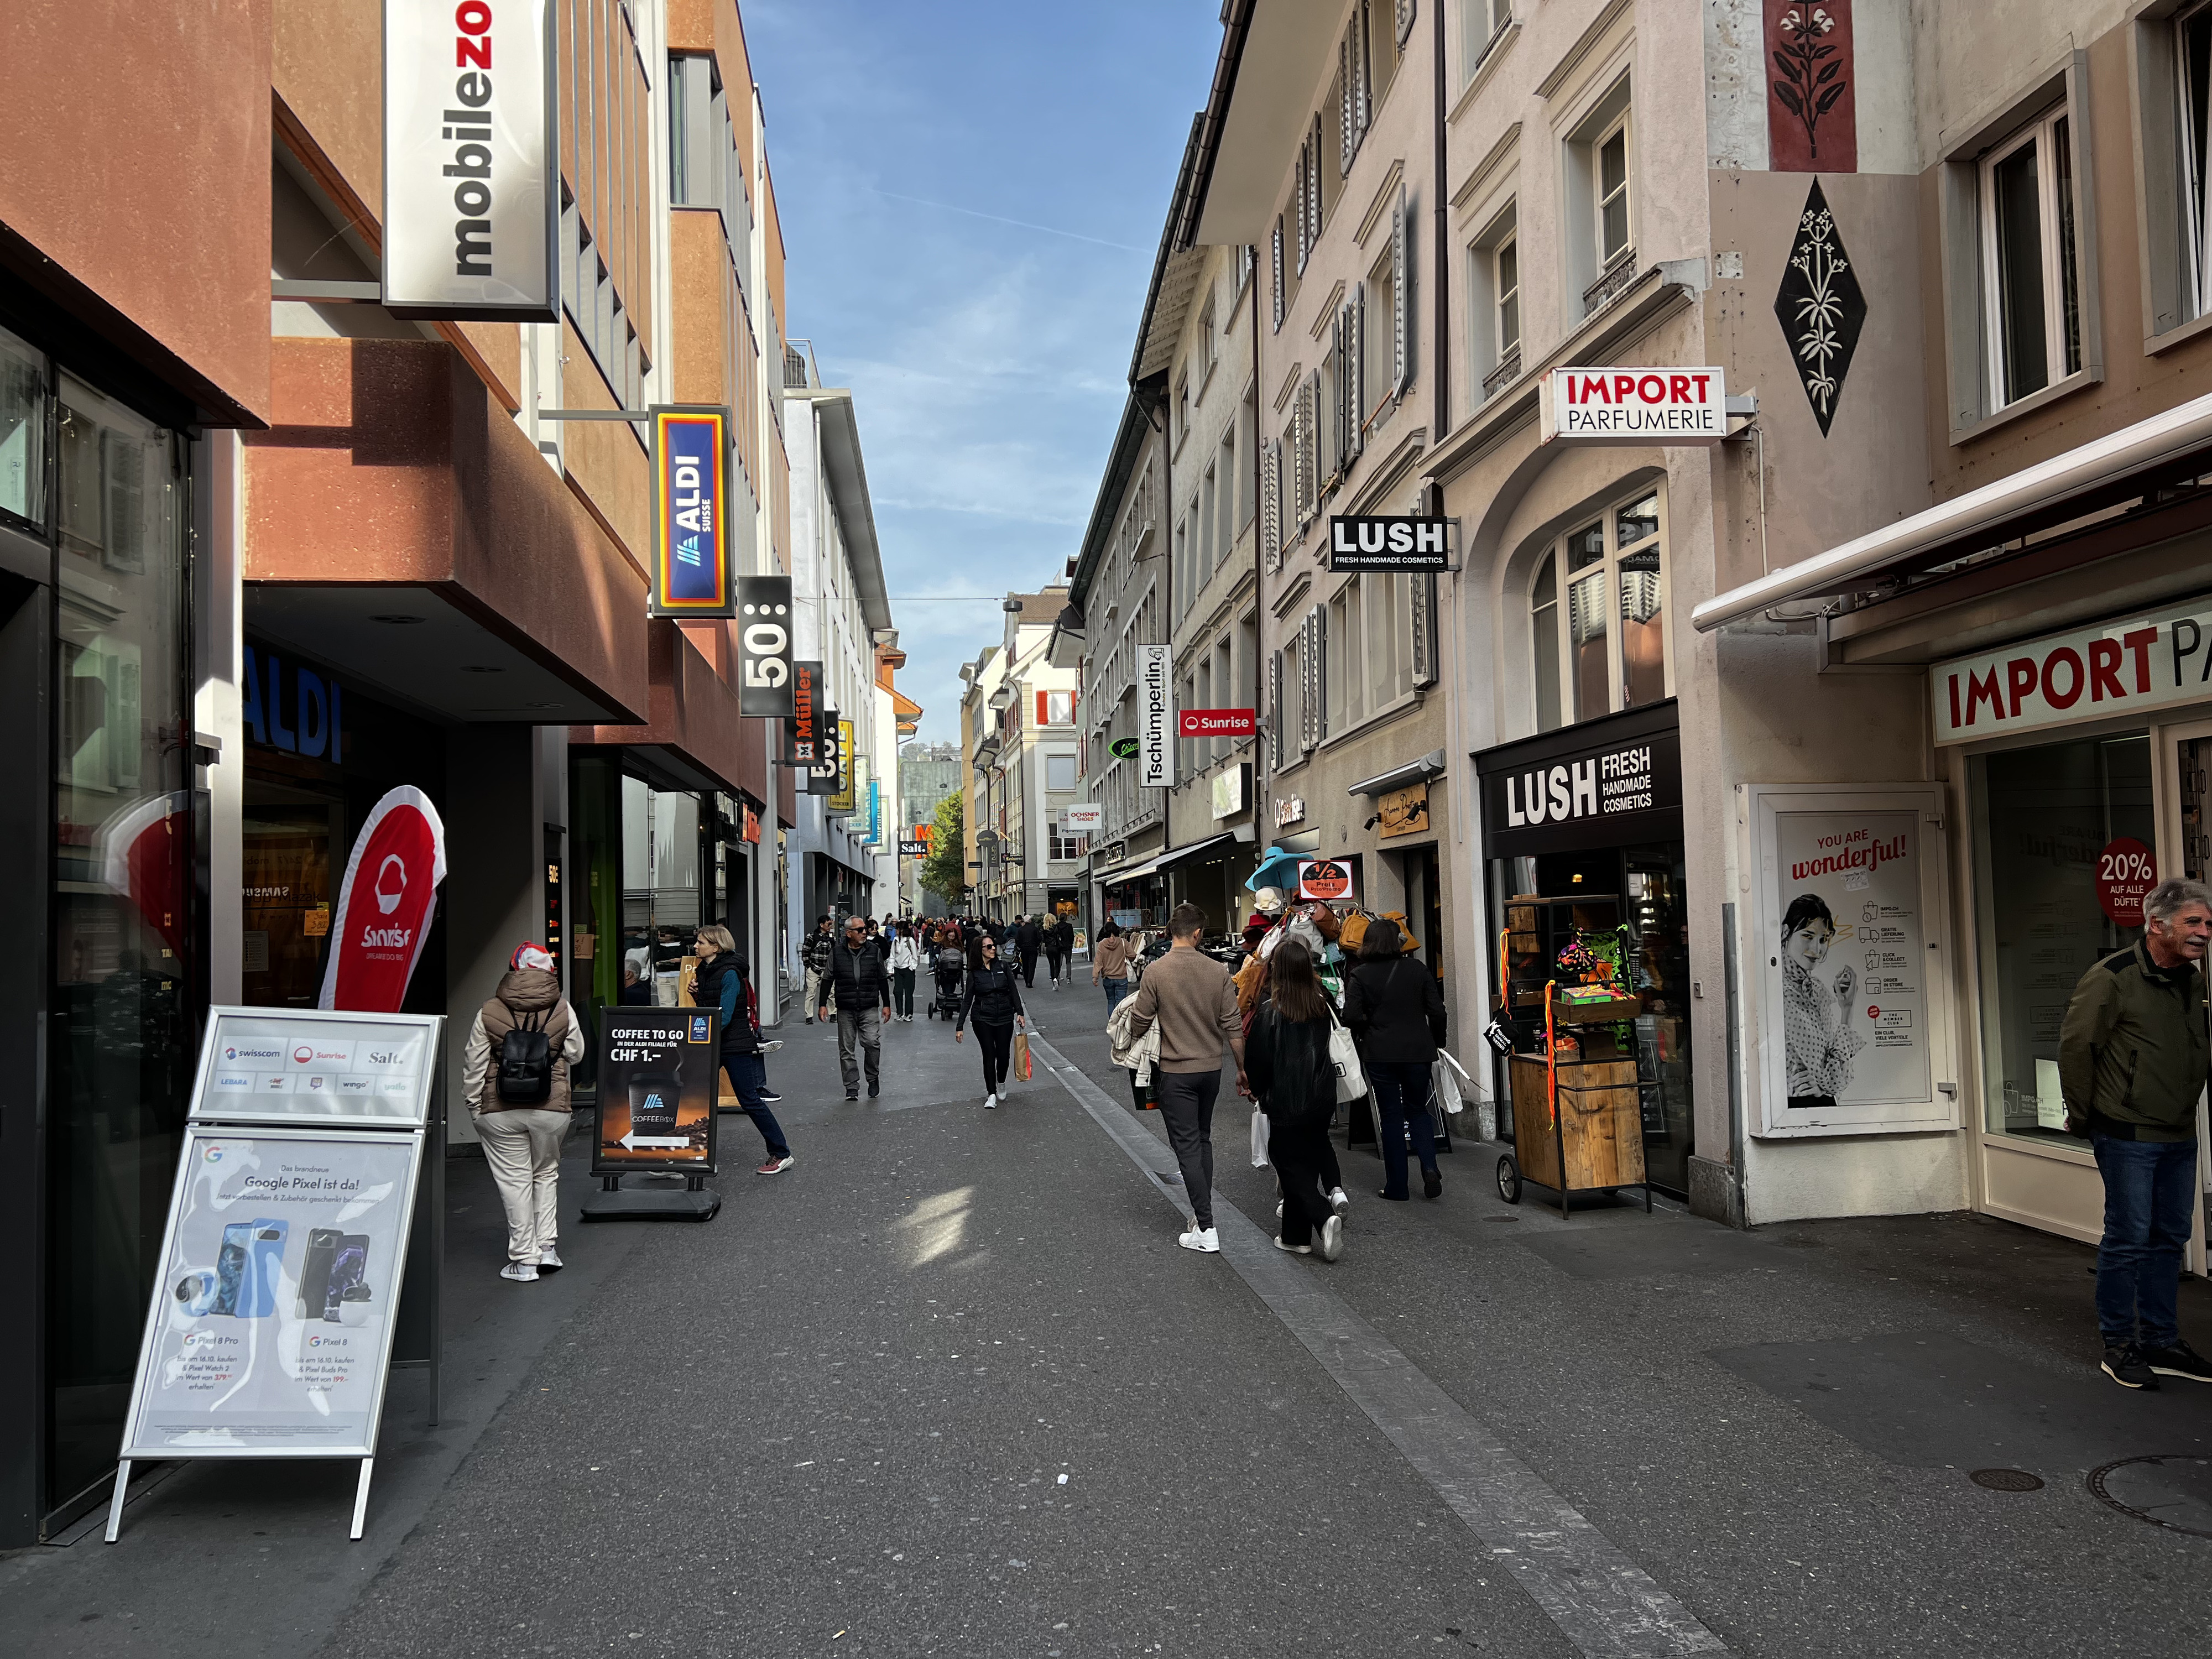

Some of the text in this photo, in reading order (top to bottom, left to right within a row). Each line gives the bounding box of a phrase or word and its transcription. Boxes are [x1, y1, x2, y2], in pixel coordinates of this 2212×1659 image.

[1567, 374, 1710, 404] IMPORT
[1568, 409, 1713, 430] PARFUMERIE
[675, 455, 701, 533] ALDI
[702, 498, 711, 533] SUISSE
[1334, 523, 1443, 552] LUSH
[1948, 625, 2158, 729] IMPORT
[243, 644, 342, 765] ALDI
[796, 667, 812, 738] Müller
[1145, 661, 1165, 784] Tschümperlin
[1201, 716, 1249, 728] Sunrise
[1601, 747, 1650, 779] FRESH
[1507, 759, 1598, 827] LUSH
[1603, 774, 1651, 796] HANDMADE
[1603, 792, 1652, 813] COSMETICS
[901, 843, 926, 853] Salt.
[1817, 829, 1869, 849] YOU ARE
[1792, 834, 1906, 880] wonderful!
[2101, 853, 2152, 880] 20%
[1313, 863, 1337, 878] 1/2
[2110, 885, 2144, 894] AUF ALLE
[612, 1029, 650, 1039] COFFEE
[652, 1030, 666, 1040] TO
[668, 1030, 684, 1040] GO
[1492, 1036, 1505, 1051] TESTING
[1496, 1028, 1511, 1045] FIGHTING
[238, 1048, 280, 1058] swisscom
[368, 1052, 404, 1064] Salt.
[611, 1048, 639, 1062] CHF
[244, 1176, 359, 1191] Google Pixel ist da!
[309, 1195, 342, 1204] geschenkt
[322, 1338, 341, 1346] Pixel
